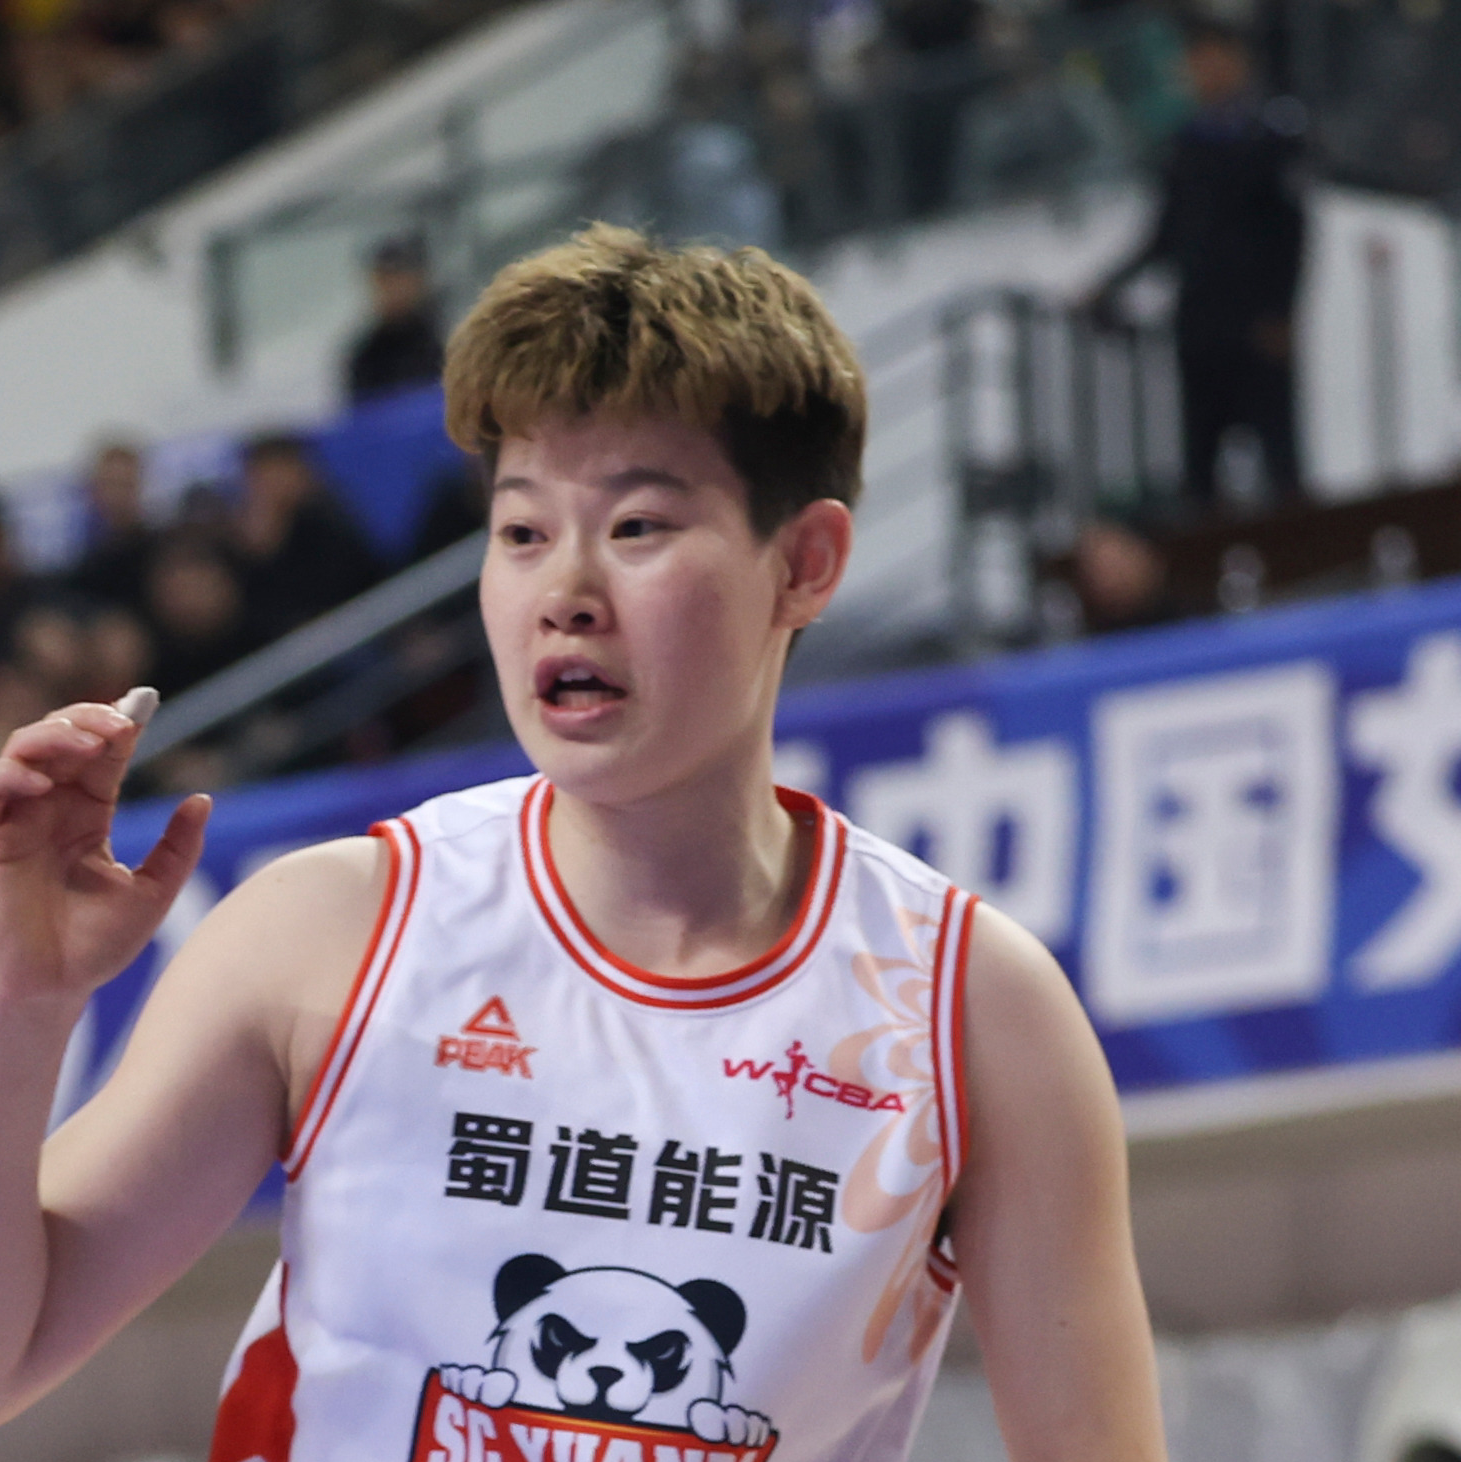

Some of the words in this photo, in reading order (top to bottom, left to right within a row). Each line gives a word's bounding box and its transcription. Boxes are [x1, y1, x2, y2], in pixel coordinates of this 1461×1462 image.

[434, 1034, 538, 1080] PEAK
[722, 1052, 906, 1115] WCBA
[444, 1111, 841, 1254] 蜀道能源
